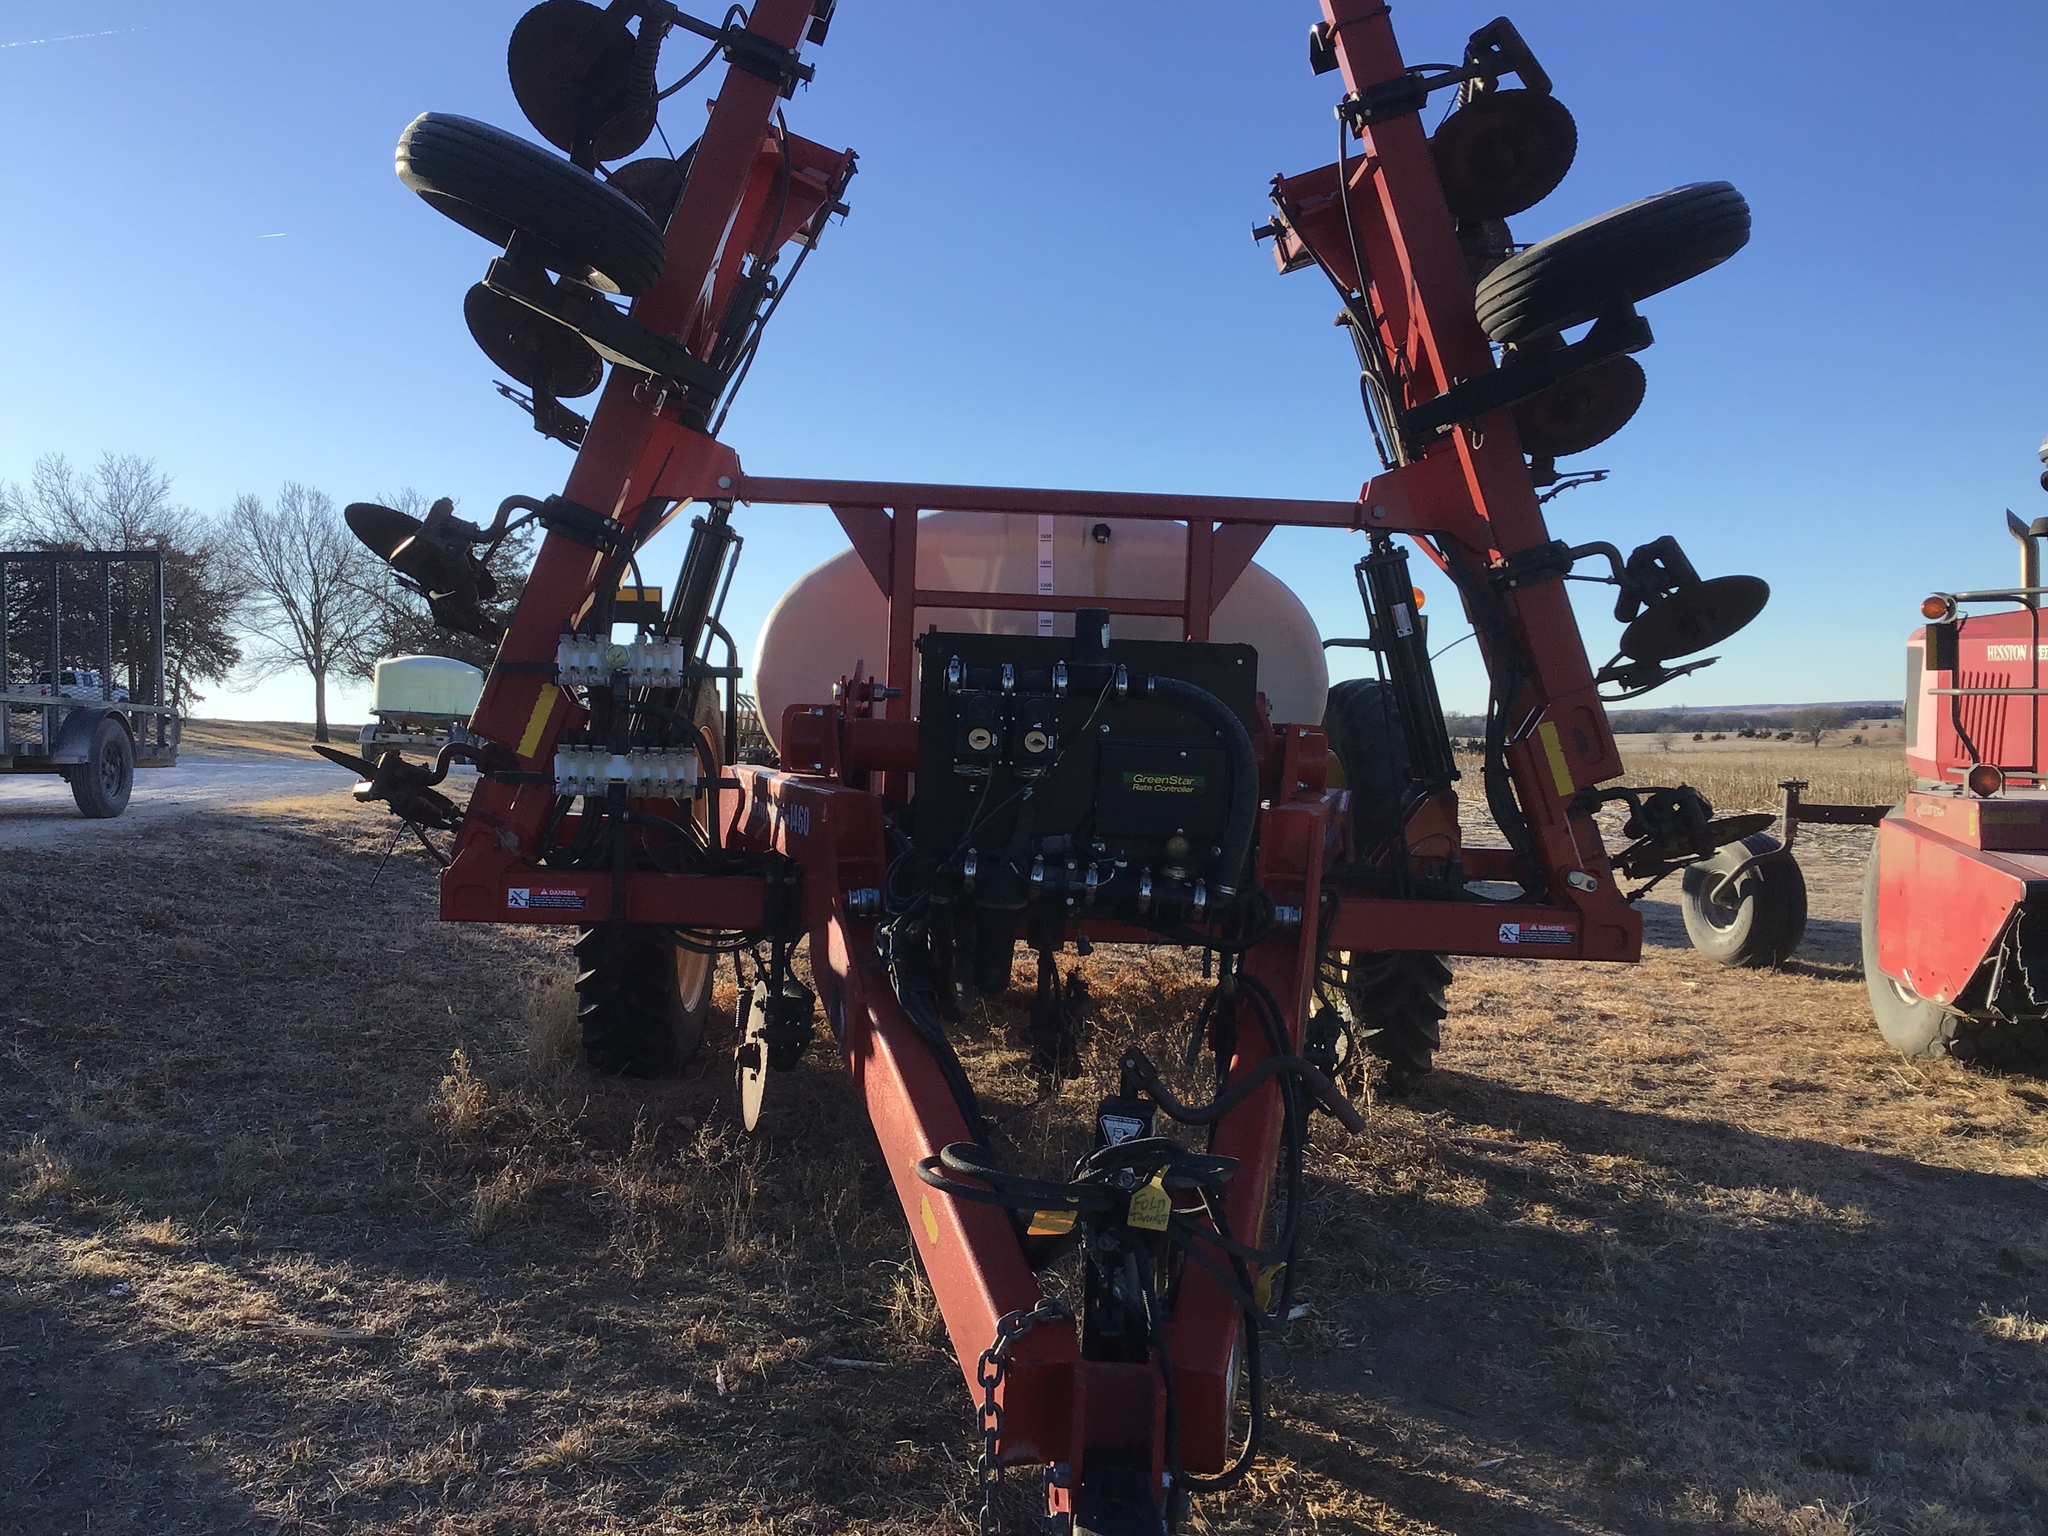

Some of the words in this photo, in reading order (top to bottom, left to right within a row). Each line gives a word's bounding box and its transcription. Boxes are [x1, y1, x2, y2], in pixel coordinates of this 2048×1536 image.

[1987, 644, 2027, 662] HESSTON
[1133, 774, 1194, 785] GreenStar
[1154, 785, 1194, 793] Controller
